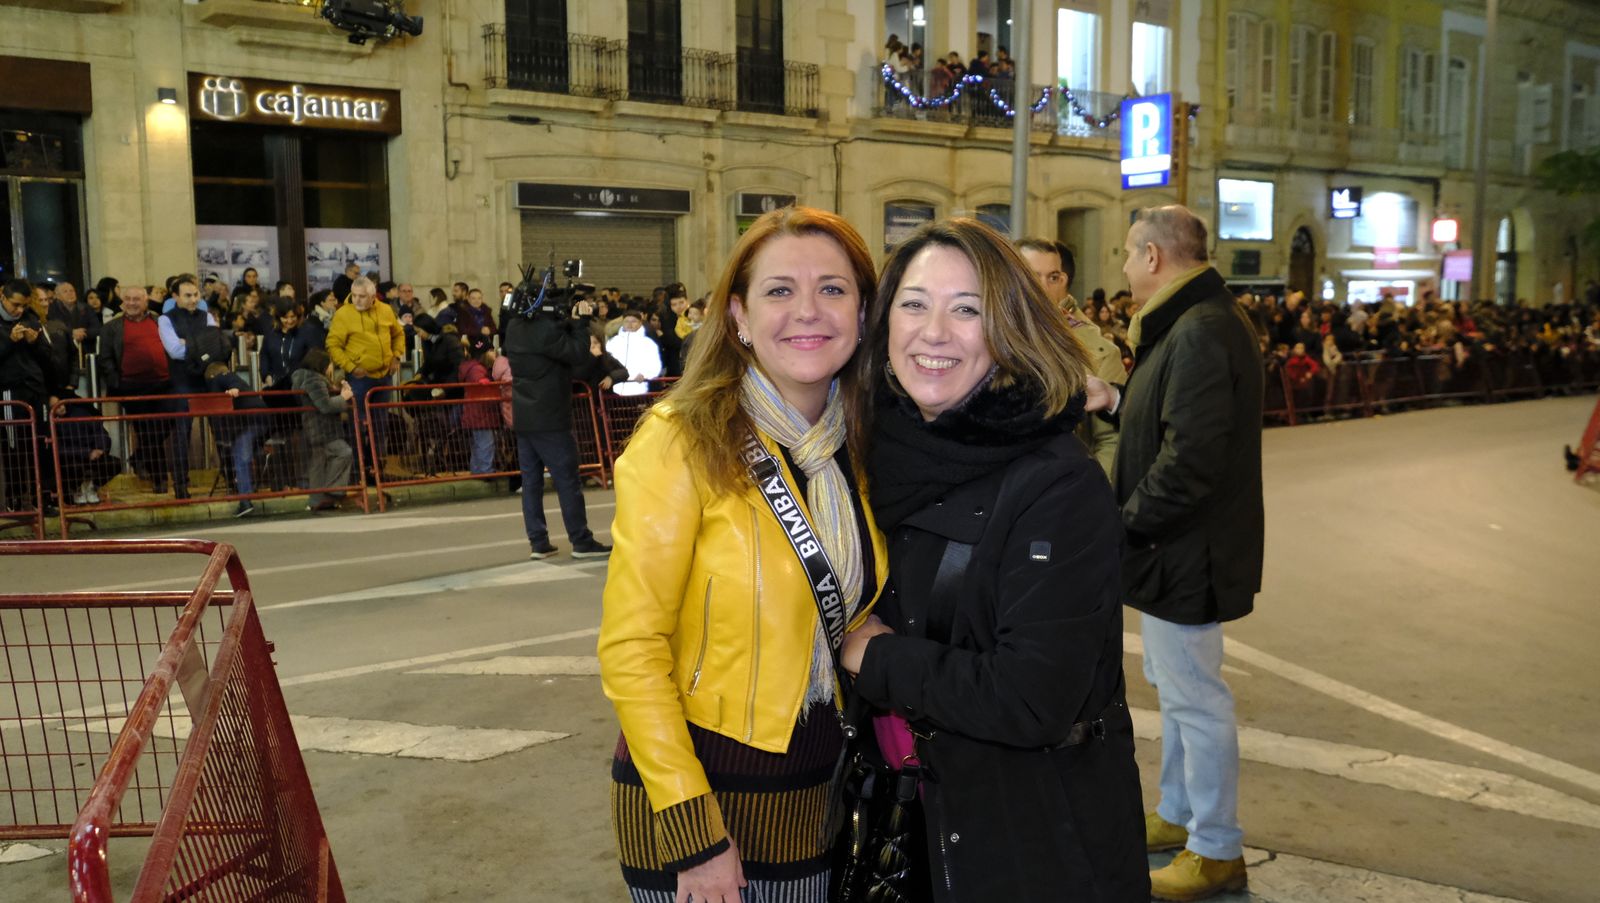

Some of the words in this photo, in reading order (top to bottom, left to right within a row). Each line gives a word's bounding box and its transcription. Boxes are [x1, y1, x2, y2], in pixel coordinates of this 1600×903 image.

[255, 84, 389, 126] cajamar
[765, 475, 820, 559] BIMBA
[816, 572, 845, 650] BIMBA
